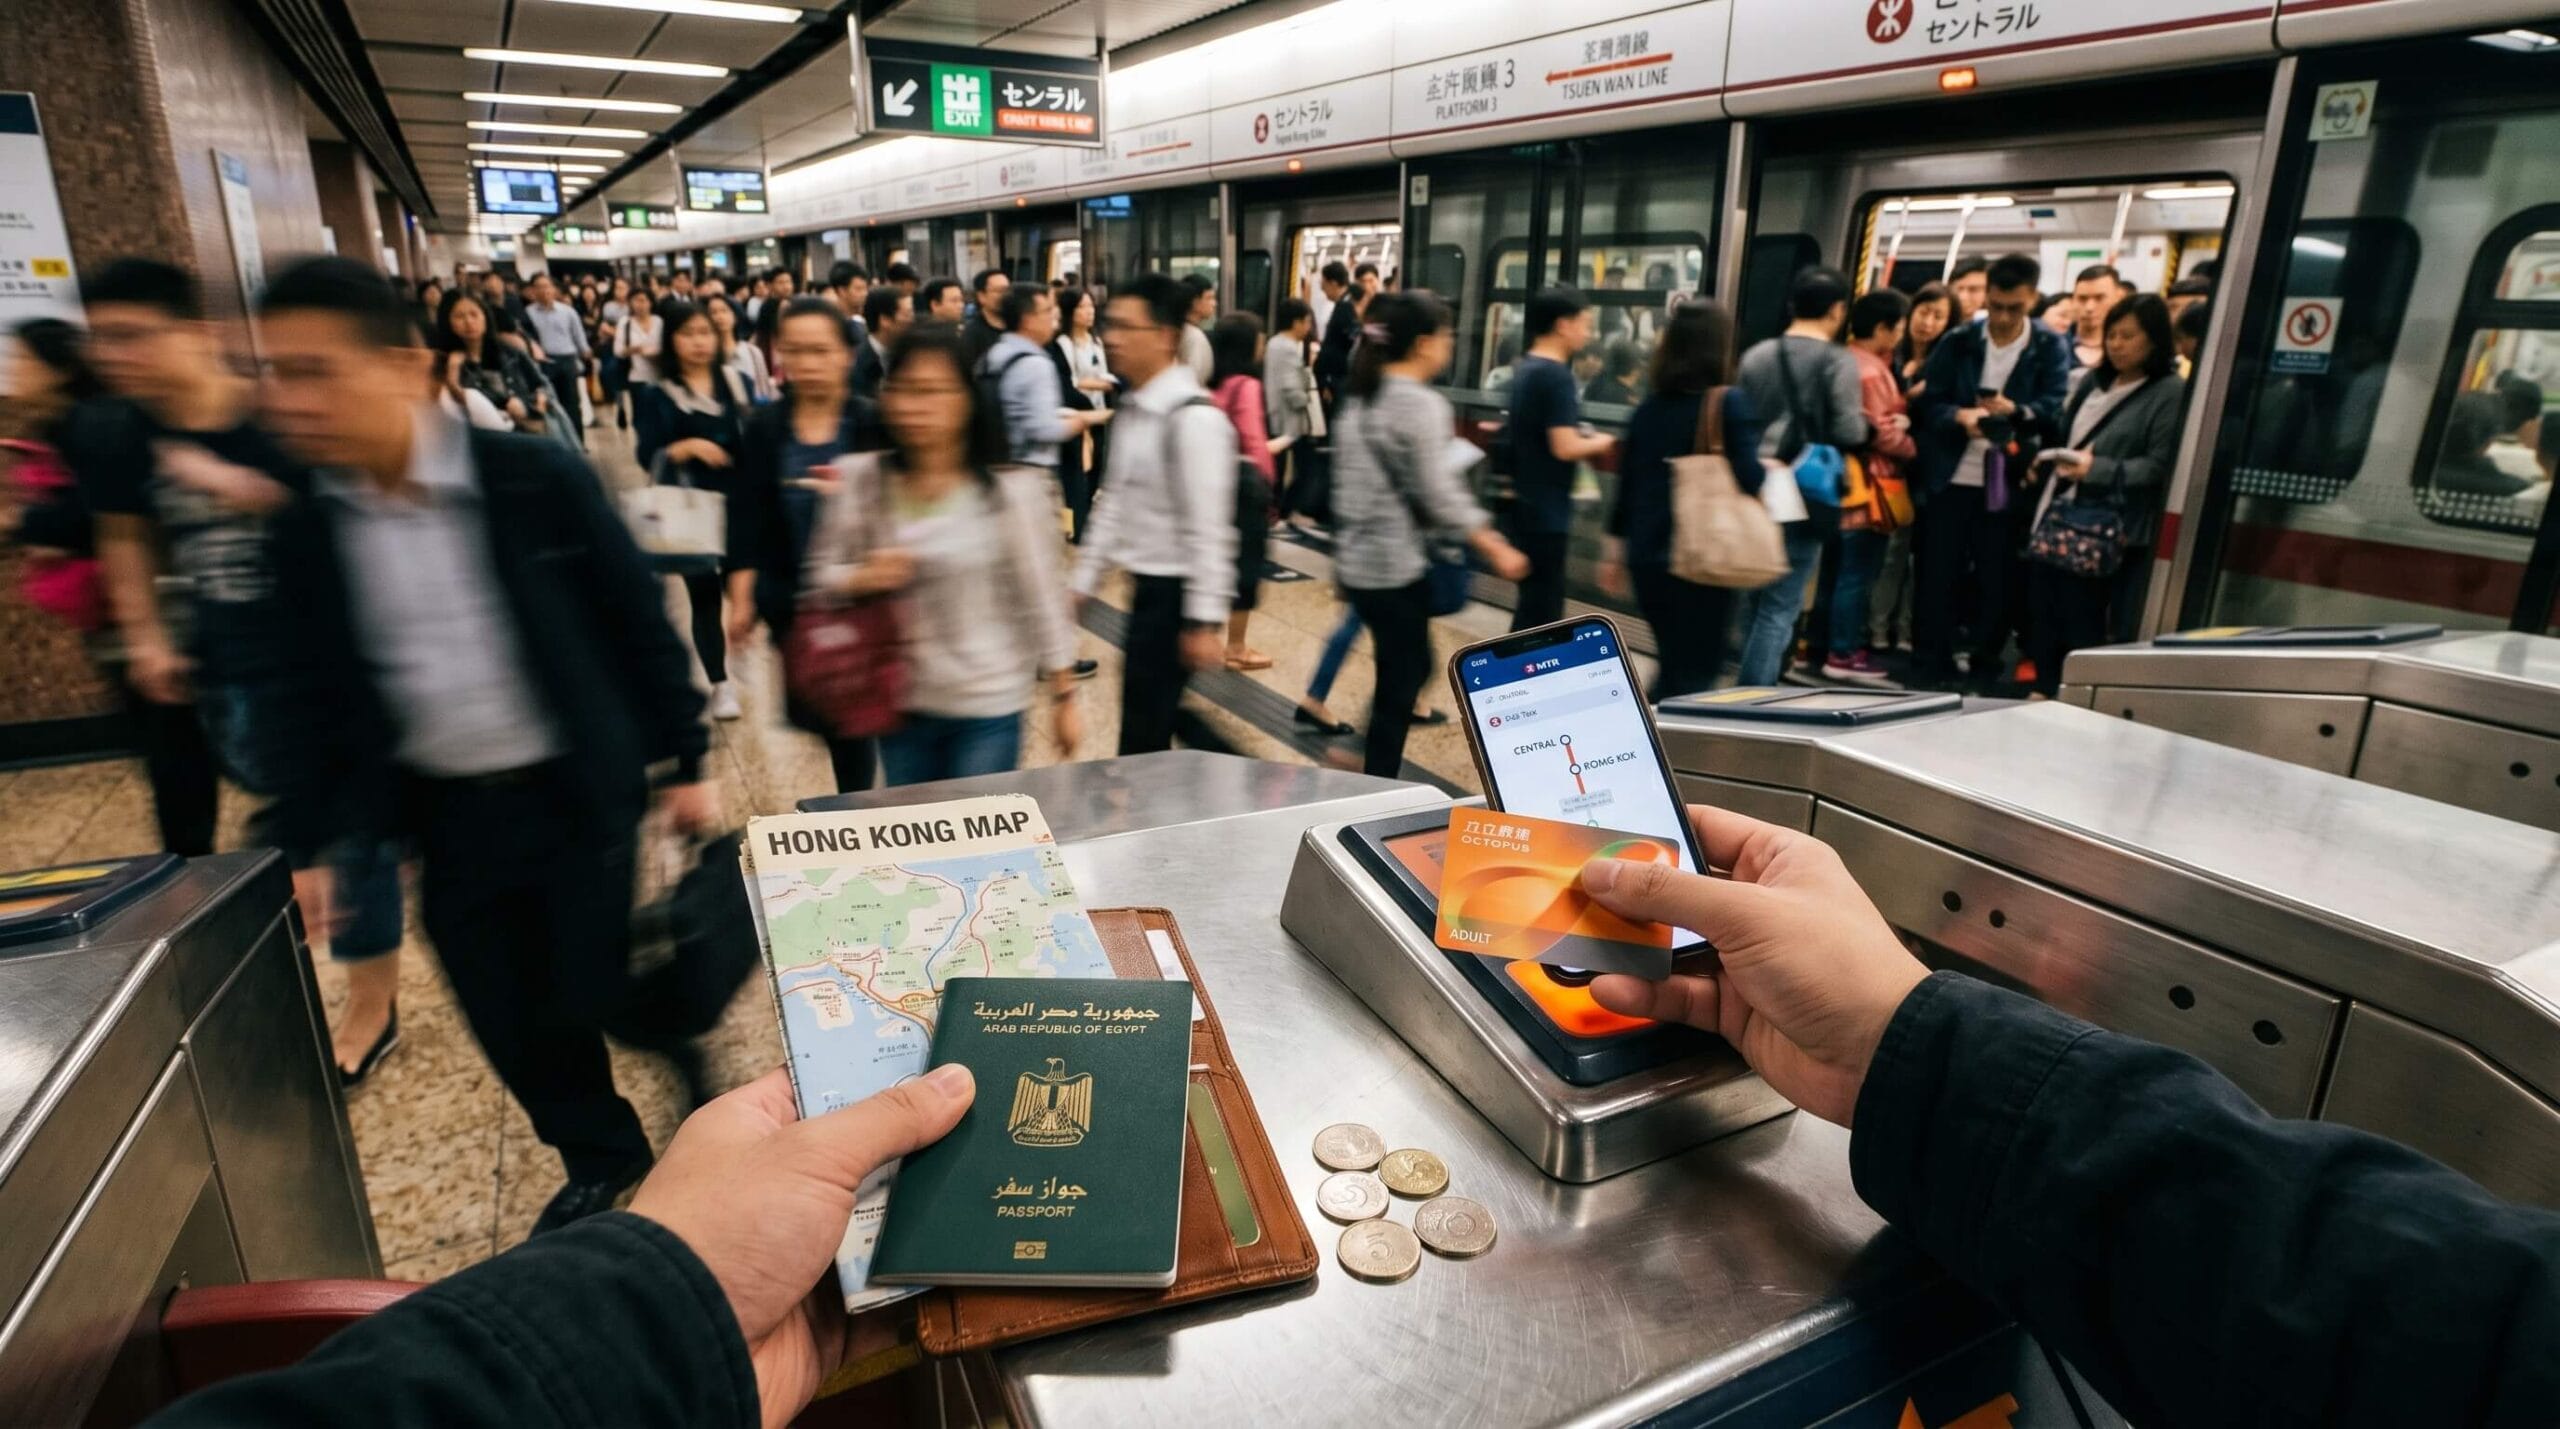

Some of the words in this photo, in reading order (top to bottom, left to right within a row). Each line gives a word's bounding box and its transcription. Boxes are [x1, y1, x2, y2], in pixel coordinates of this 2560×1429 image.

[1926, 3, 2040, 44] セントラル
[1504, 58, 1515, 89] 3
[1562, 79, 1600, 100] TSUEN
[1604, 74, 1634, 94] WAN
[1638, 67, 1669, 88] LINE
[1002, 81, 1086, 112] センラル
[1275, 98, 1333, 128] セントラル
[1436, 98, 1489, 119] PLATFORM
[1491, 96, 1498, 112] 3
[943, 111, 981, 127] EXIT
[1536, 658, 1560, 671] MTR
[1513, 739, 1557, 755] CENTRAL
[1616, 751, 1637, 763] KOK
[767, 827, 861, 856] HONG
[869, 819, 956, 849] KONG
[962, 811, 1030, 839] MAP
[1461, 835, 1530, 853] OCTOPUS
[1449, 928, 1492, 944] ADULT
[973, 1002, 1035, 1021] العربية
[1037, 1006, 1078, 1021] مصر
[1083, 1002, 1160, 1021] جمهورية
[983, 1024, 1017, 1033] ARAB
[1020, 1024, 1082, 1034] REPUBLIC
[1085, 1024, 1102, 1034] OF
[1105, 1025, 1147, 1034] EGYPT
[990, 1176, 1034, 1199] سفر
[1037, 1176, 1088, 1200] جواز
[997, 1205, 1076, 1218] PASSPORT
